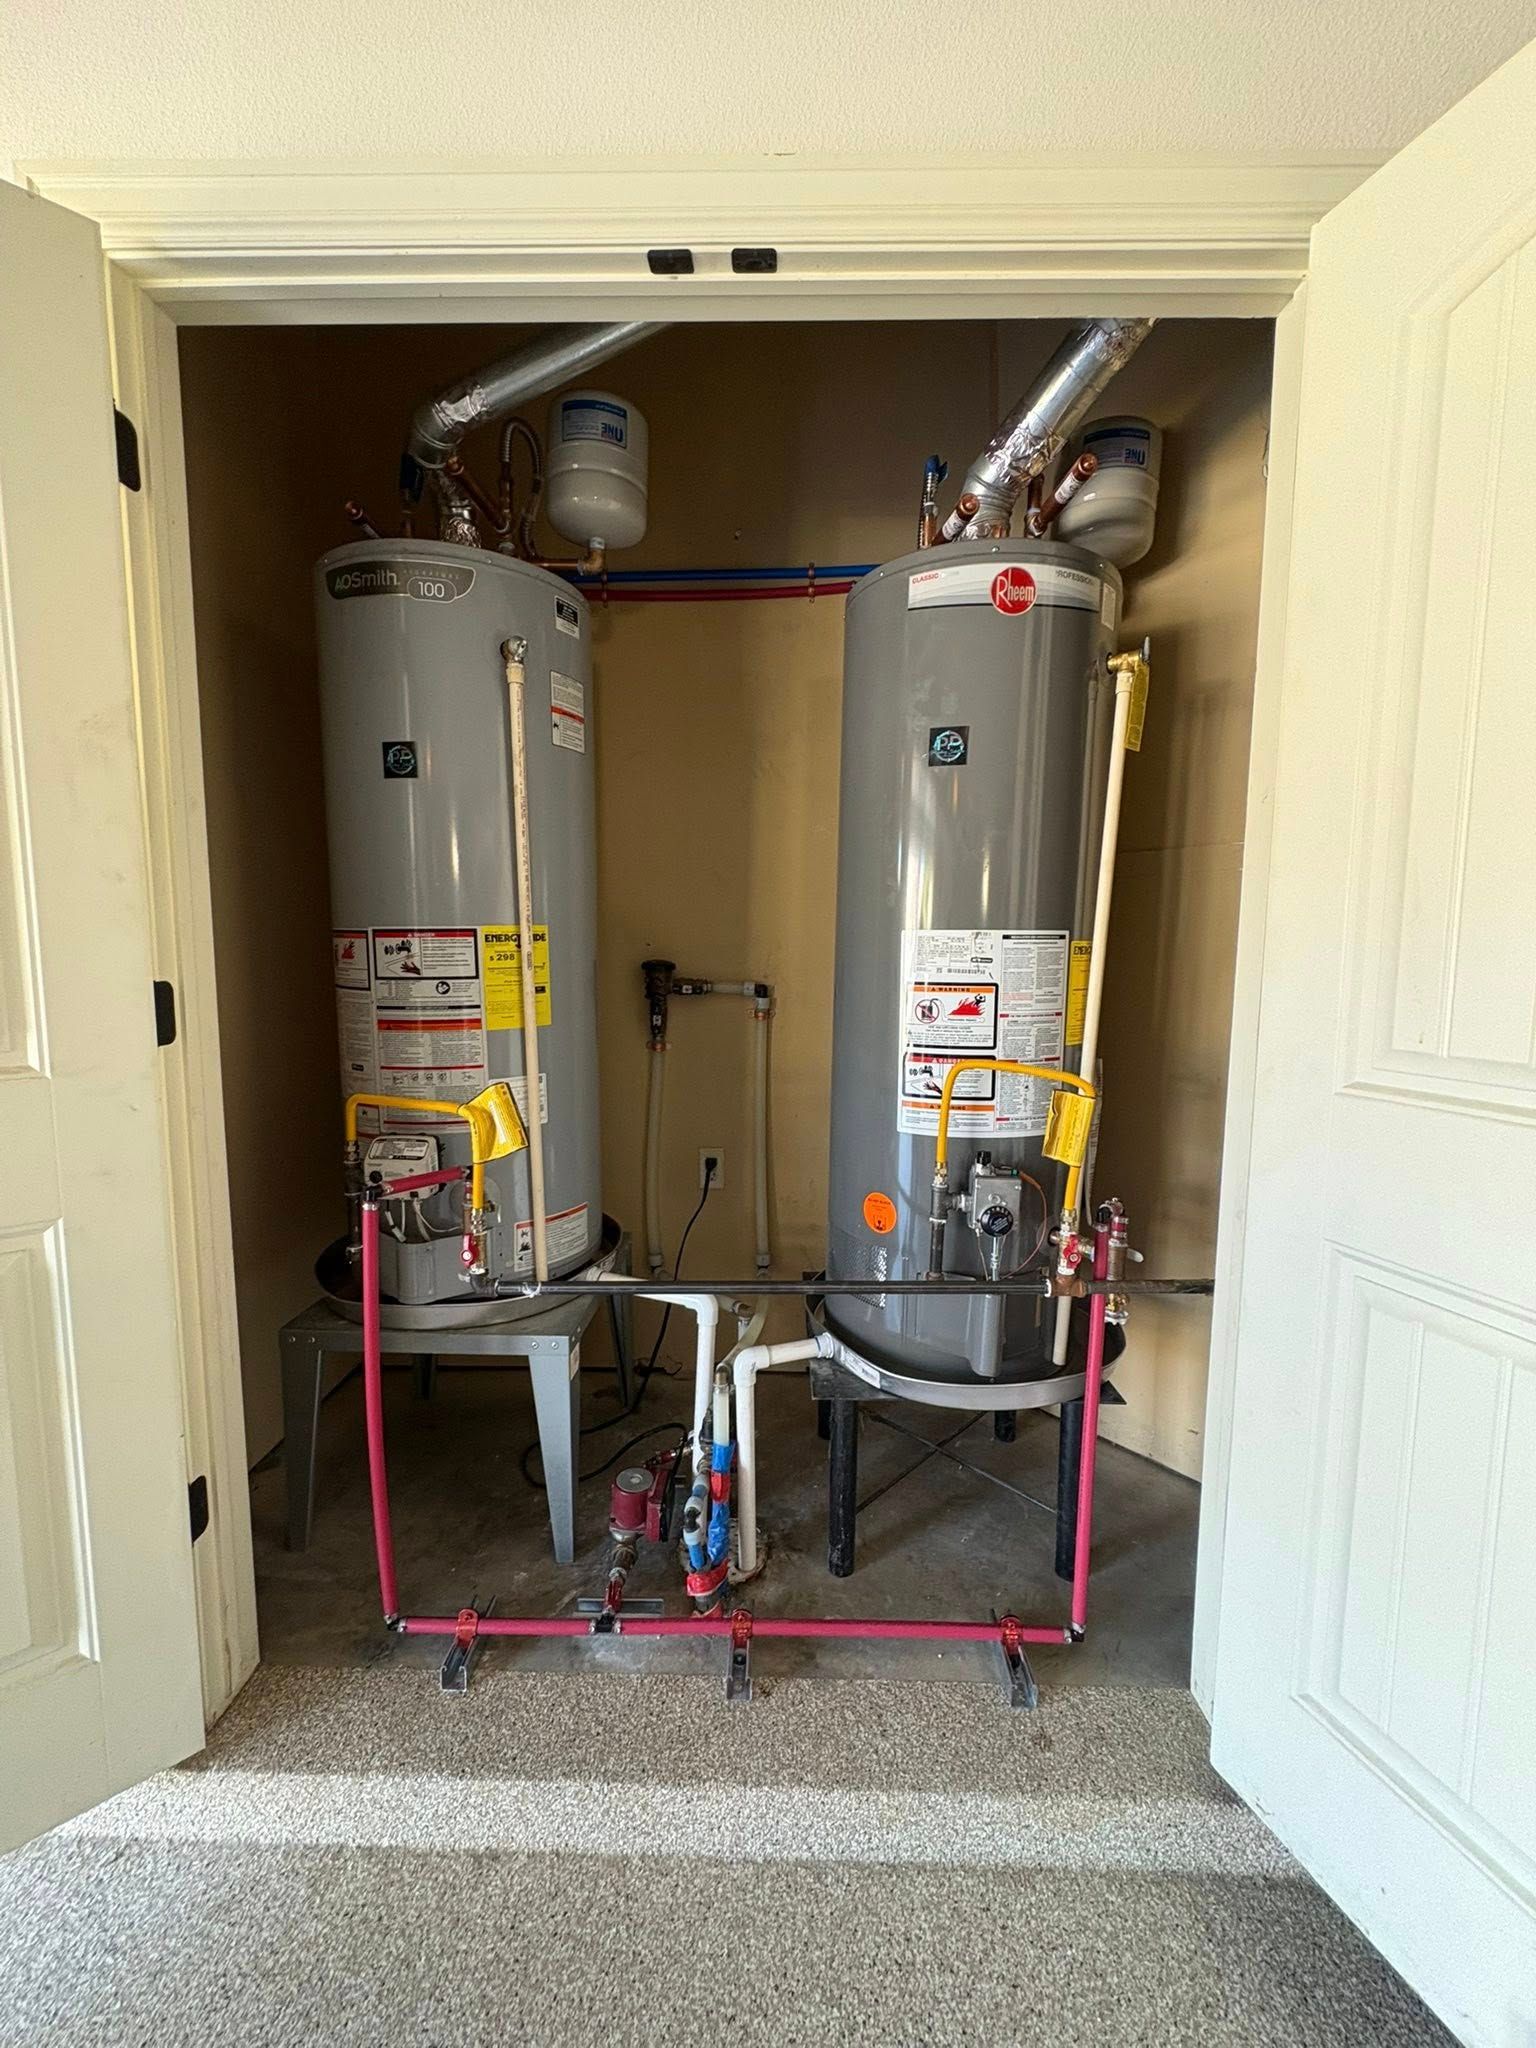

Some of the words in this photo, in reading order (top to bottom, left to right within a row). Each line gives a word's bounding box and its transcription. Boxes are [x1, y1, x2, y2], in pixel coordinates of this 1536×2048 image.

[912, 572, 939, 584] CLASSIC
[418, 581, 445, 598] 100
[996, 568, 1035, 607] Rheem
